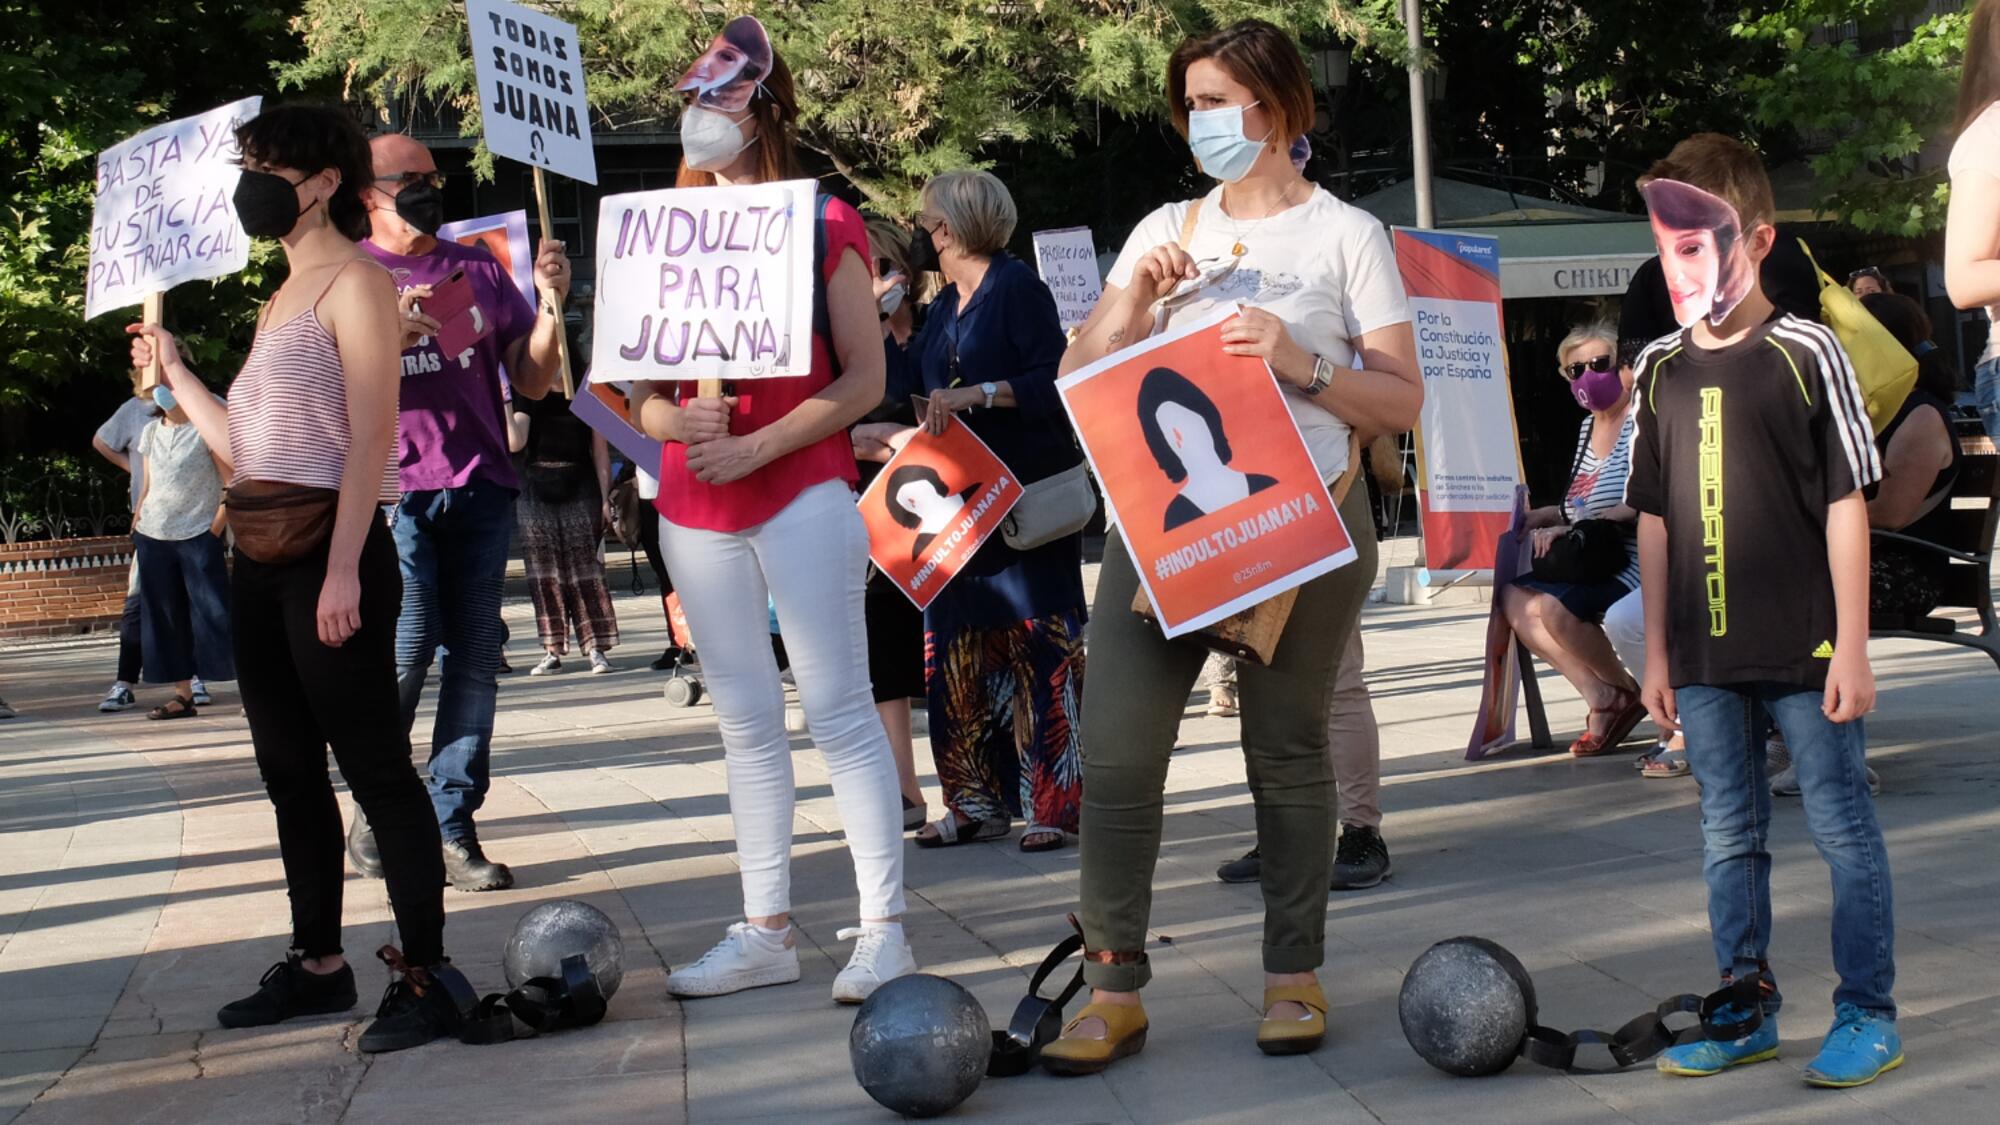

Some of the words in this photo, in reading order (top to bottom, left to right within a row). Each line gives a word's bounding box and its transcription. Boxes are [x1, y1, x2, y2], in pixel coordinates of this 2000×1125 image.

[488, 11, 567, 61] TODAS
[492, 46, 573, 95] SOMOS
[493, 80, 581, 140] JUANA
[97, 135, 182, 198] BASTA
[135, 175, 165, 209] DE
[614, 205, 788, 259] INDULTO
[659, 262, 764, 312] PARA
[1417, 310, 1439, 325] Por
[1440, 312, 1451, 326] la
[1419, 327, 1496, 347] Constitución,
[1421, 345, 1433, 359] la
[1436, 345, 1480, 362] Justicia
[1483, 352, 1490, 365] y
[1423, 365, 1445, 380] por
[1447, 363, 1492, 381] España
[910, 475, 1010, 592] #INDULTOJUANAYA
[1699, 387, 1727, 636] PREDATOR
[1154, 493, 1320, 581] #INDULTOJUANAYA
